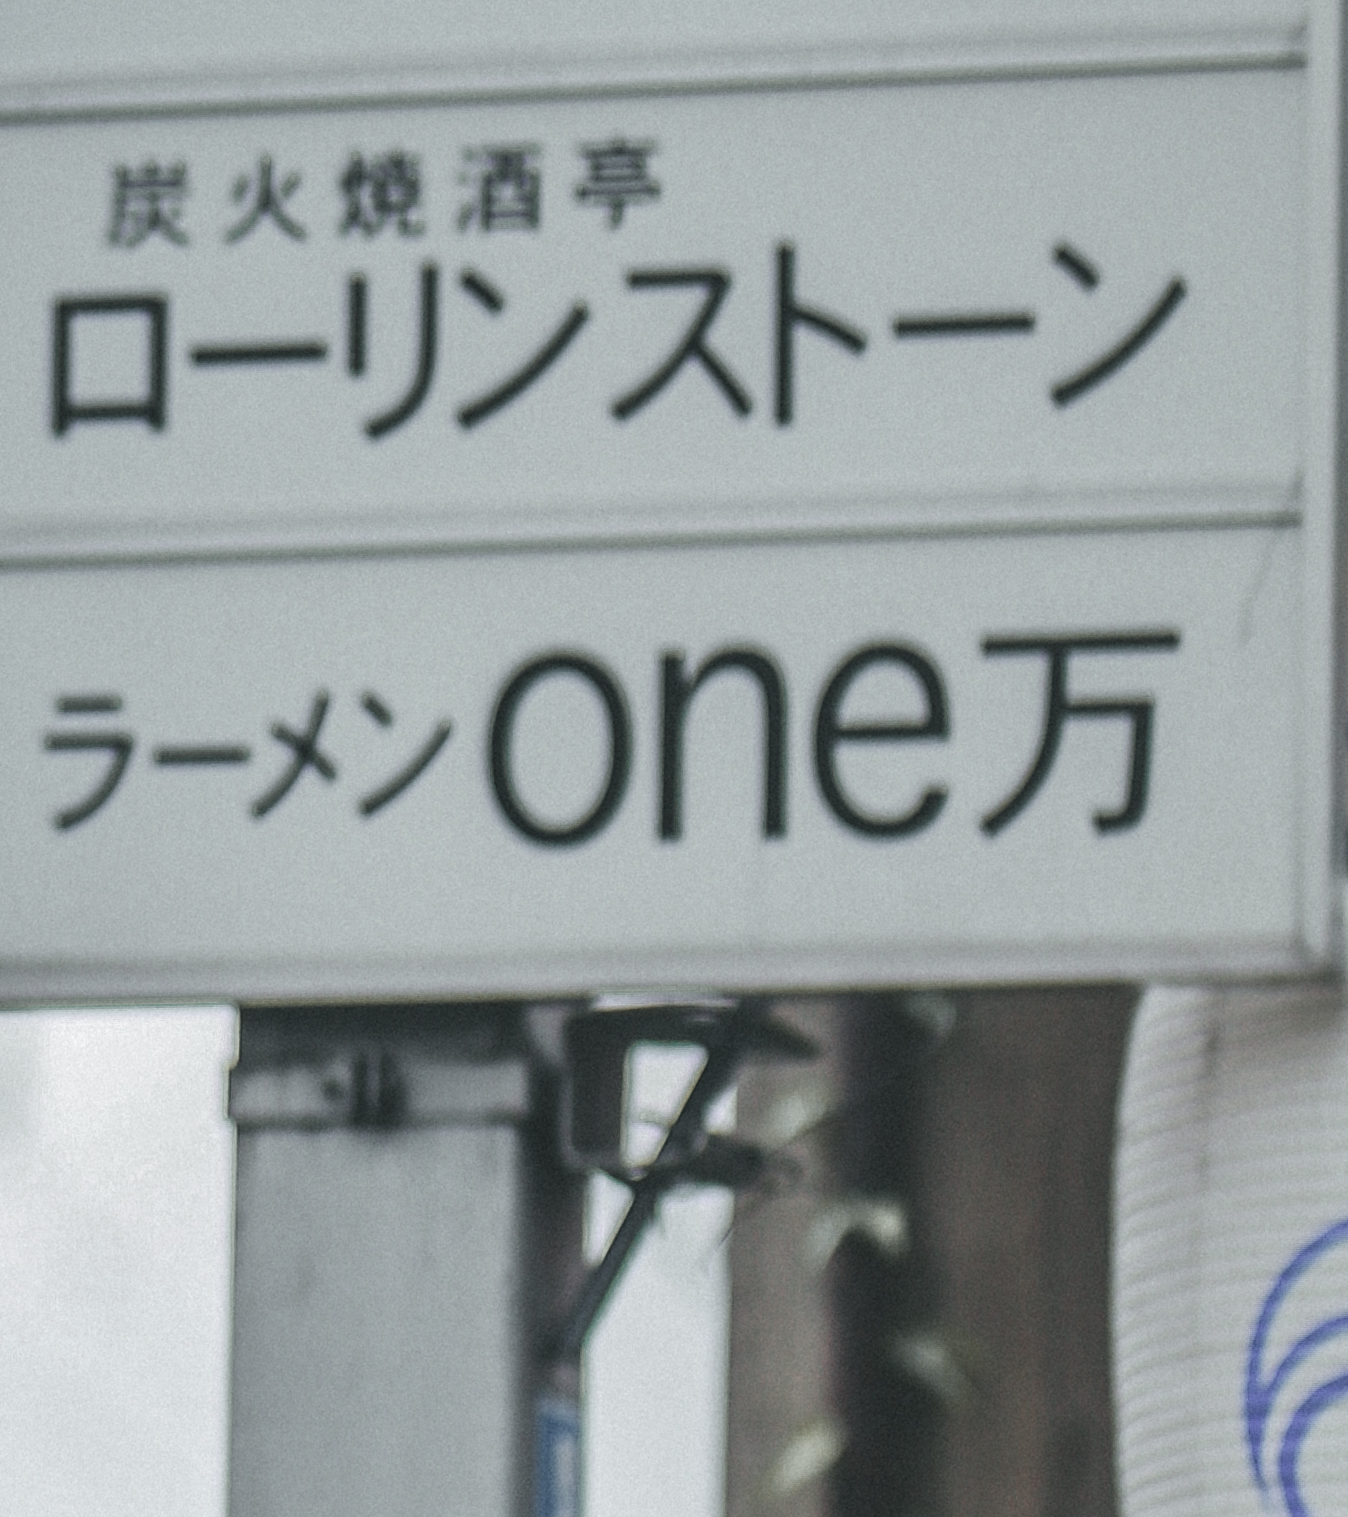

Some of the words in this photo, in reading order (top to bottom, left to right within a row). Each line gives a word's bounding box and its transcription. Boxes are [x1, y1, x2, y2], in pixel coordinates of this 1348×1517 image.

[49, 242, 1189, 441] ローリンストーン
[42, 691, 453, 834] ラーメン
